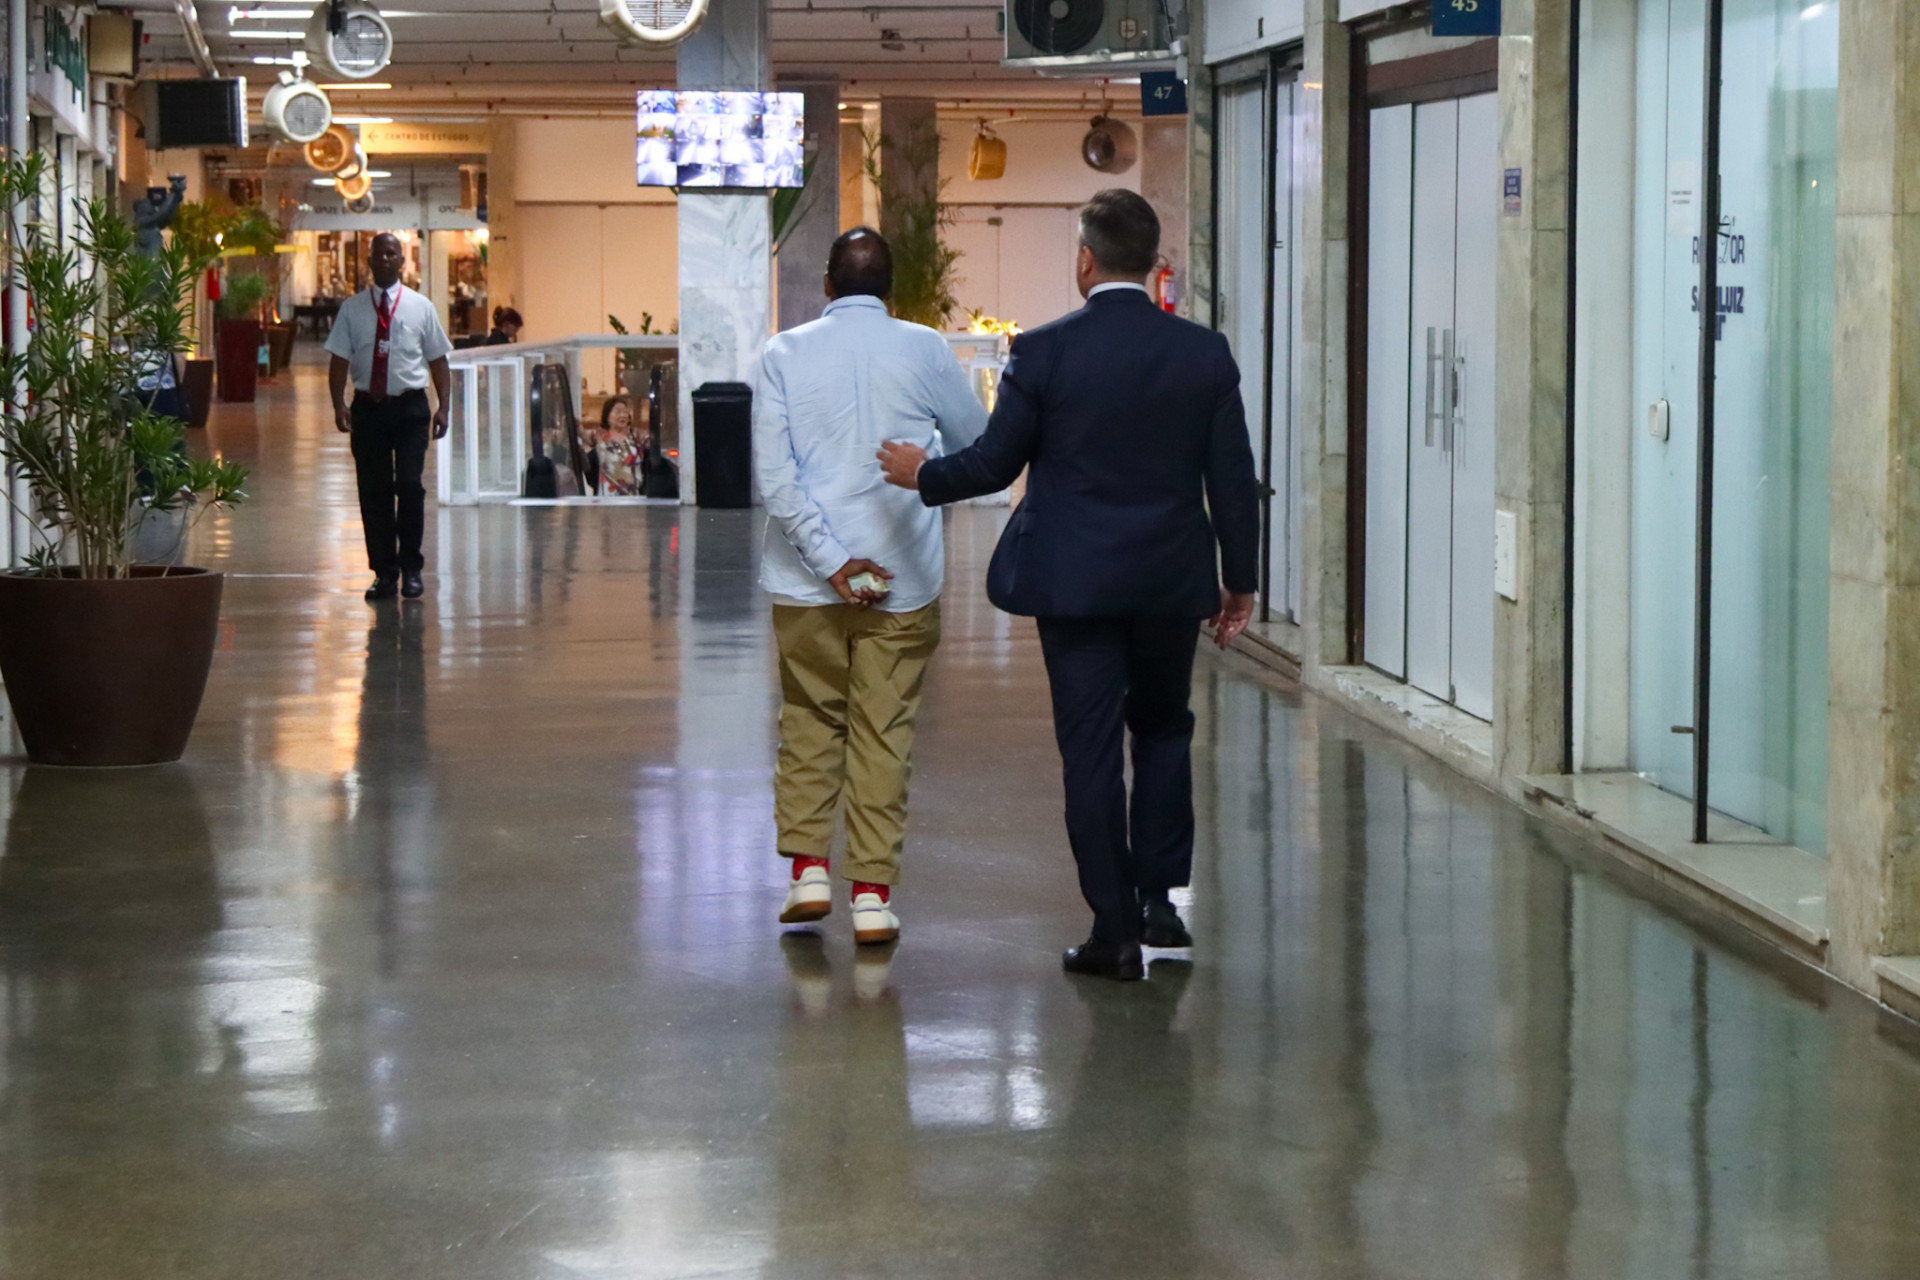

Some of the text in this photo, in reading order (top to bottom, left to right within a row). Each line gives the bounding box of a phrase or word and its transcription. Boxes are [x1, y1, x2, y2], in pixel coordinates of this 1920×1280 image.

[1451, 0, 1478, 12] 45
[1154, 86, 1173, 100] 47
[384, 132, 470, 141] CENTRO DE ESTUDOS
